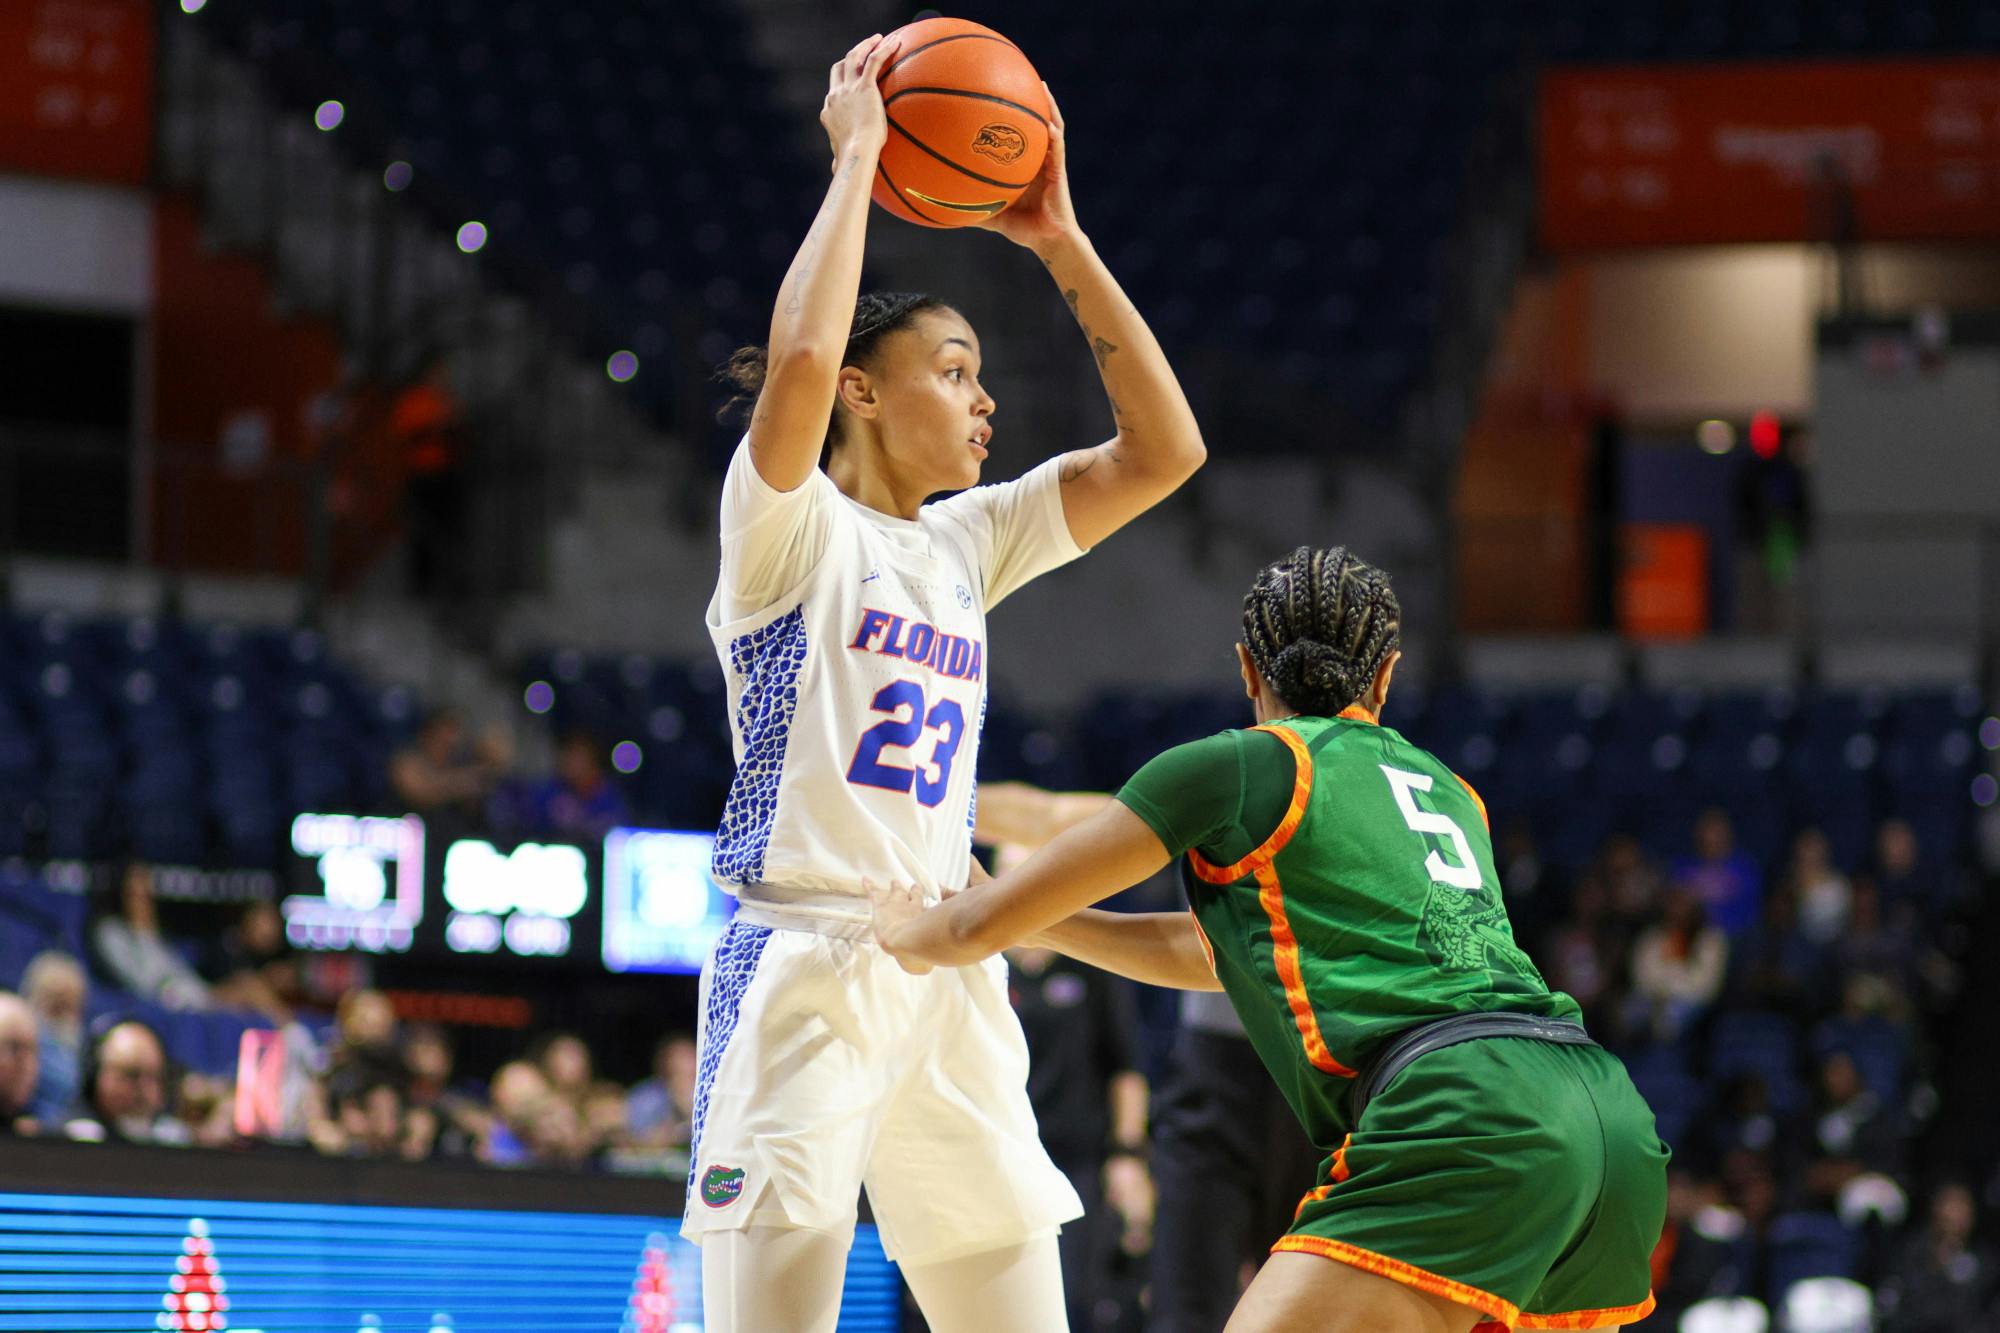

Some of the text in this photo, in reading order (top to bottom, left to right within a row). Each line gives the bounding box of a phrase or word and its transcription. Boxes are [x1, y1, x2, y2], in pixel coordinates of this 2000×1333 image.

[847, 608, 982, 682] FLOIDA
[846, 679, 965, 808] 23
[1378, 764, 1483, 890] 5
